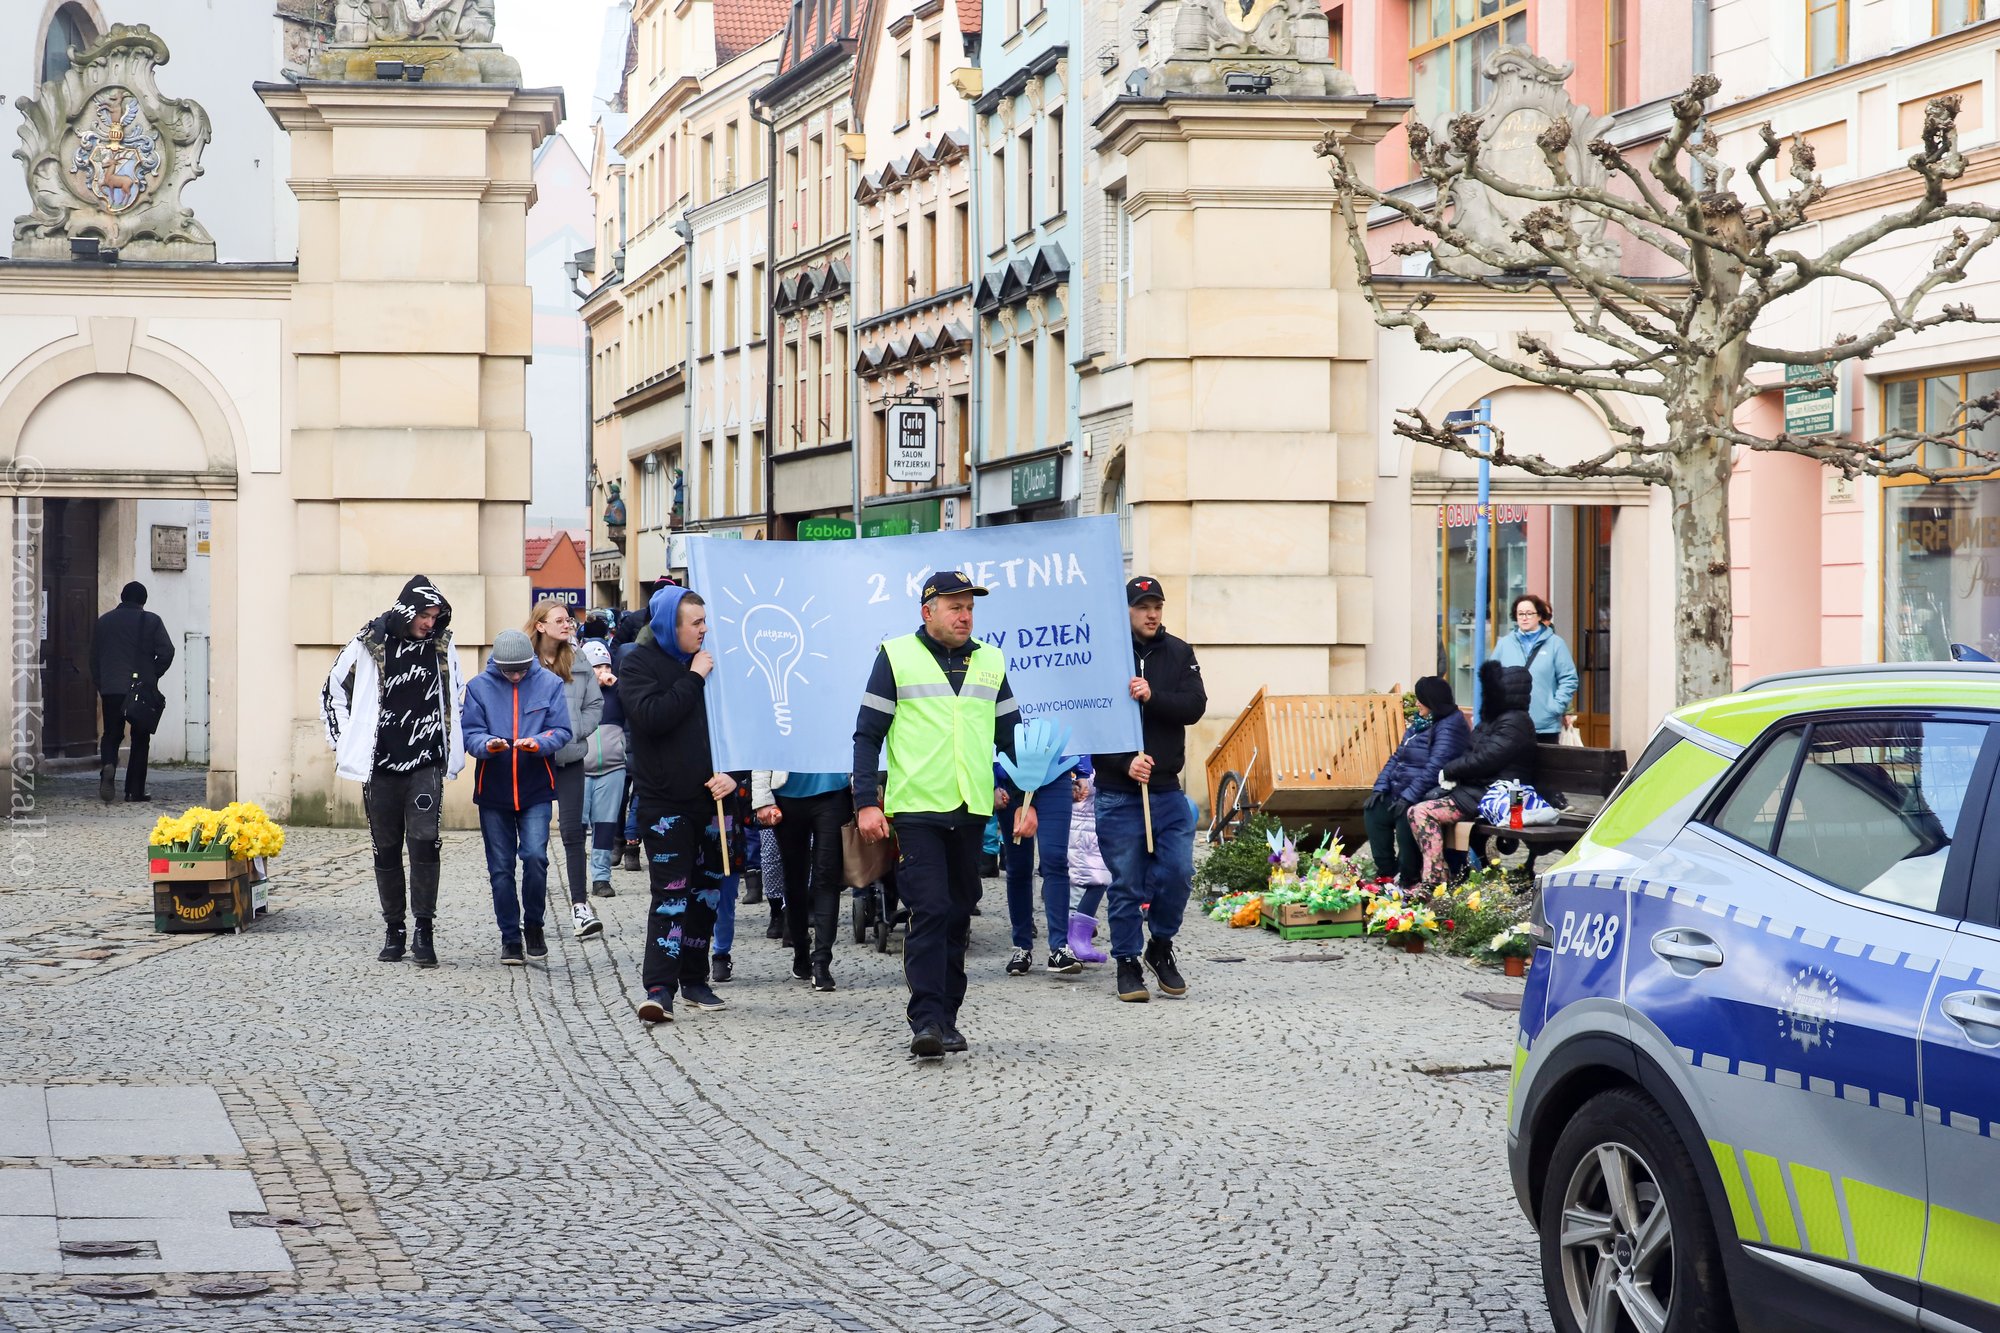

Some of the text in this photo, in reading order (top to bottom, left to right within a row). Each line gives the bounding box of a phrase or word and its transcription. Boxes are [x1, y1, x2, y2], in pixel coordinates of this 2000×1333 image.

[902, 413, 923, 430] Carlo
[902, 430, 923, 447] Biani
[902, 450, 923, 458] SALON
[893, 460, 931, 468] FRYZJERSKI
[806, 523, 852, 537] żabka
[867, 552, 1088, 604] 2 KIETNIA
[538, 592, 578, 605] CASIO
[1017, 613, 1091, 648] DZIEŃ
[1009, 650, 1092, 672] AUTYZMU
[1018, 697, 1113, 714] NO-WYCHOWAWCZY
[1556, 910, 1620, 960] B438
[1800, 1022, 1811, 1033] 112
